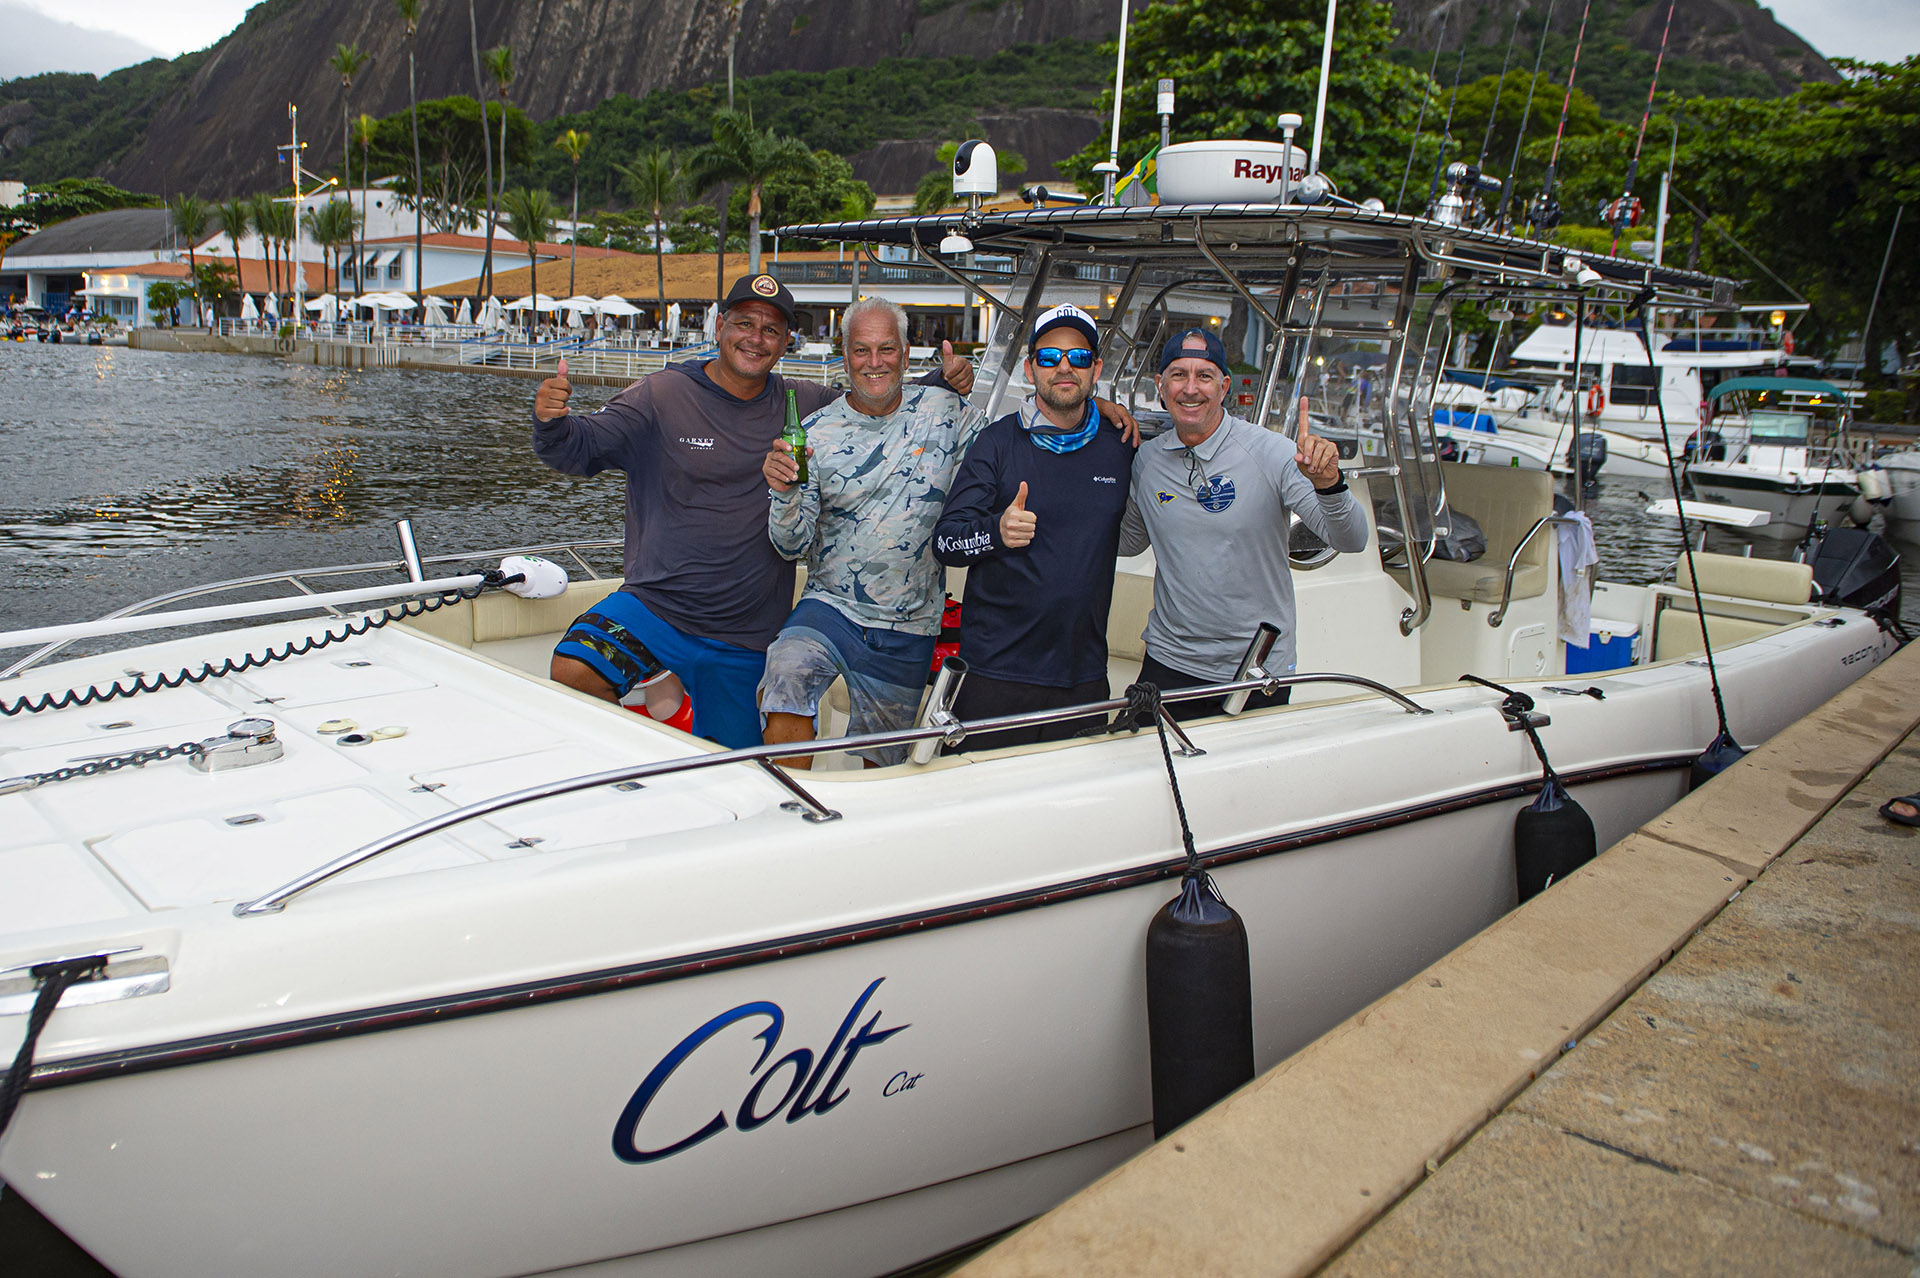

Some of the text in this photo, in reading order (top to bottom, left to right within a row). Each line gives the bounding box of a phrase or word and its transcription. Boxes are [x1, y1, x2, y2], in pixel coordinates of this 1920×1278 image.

[1056, 309, 1079, 318] COLT
[946, 531, 990, 552] Columbia
[964, 545, 994, 556] PFG
[611, 976, 925, 1165] Colt Cat
